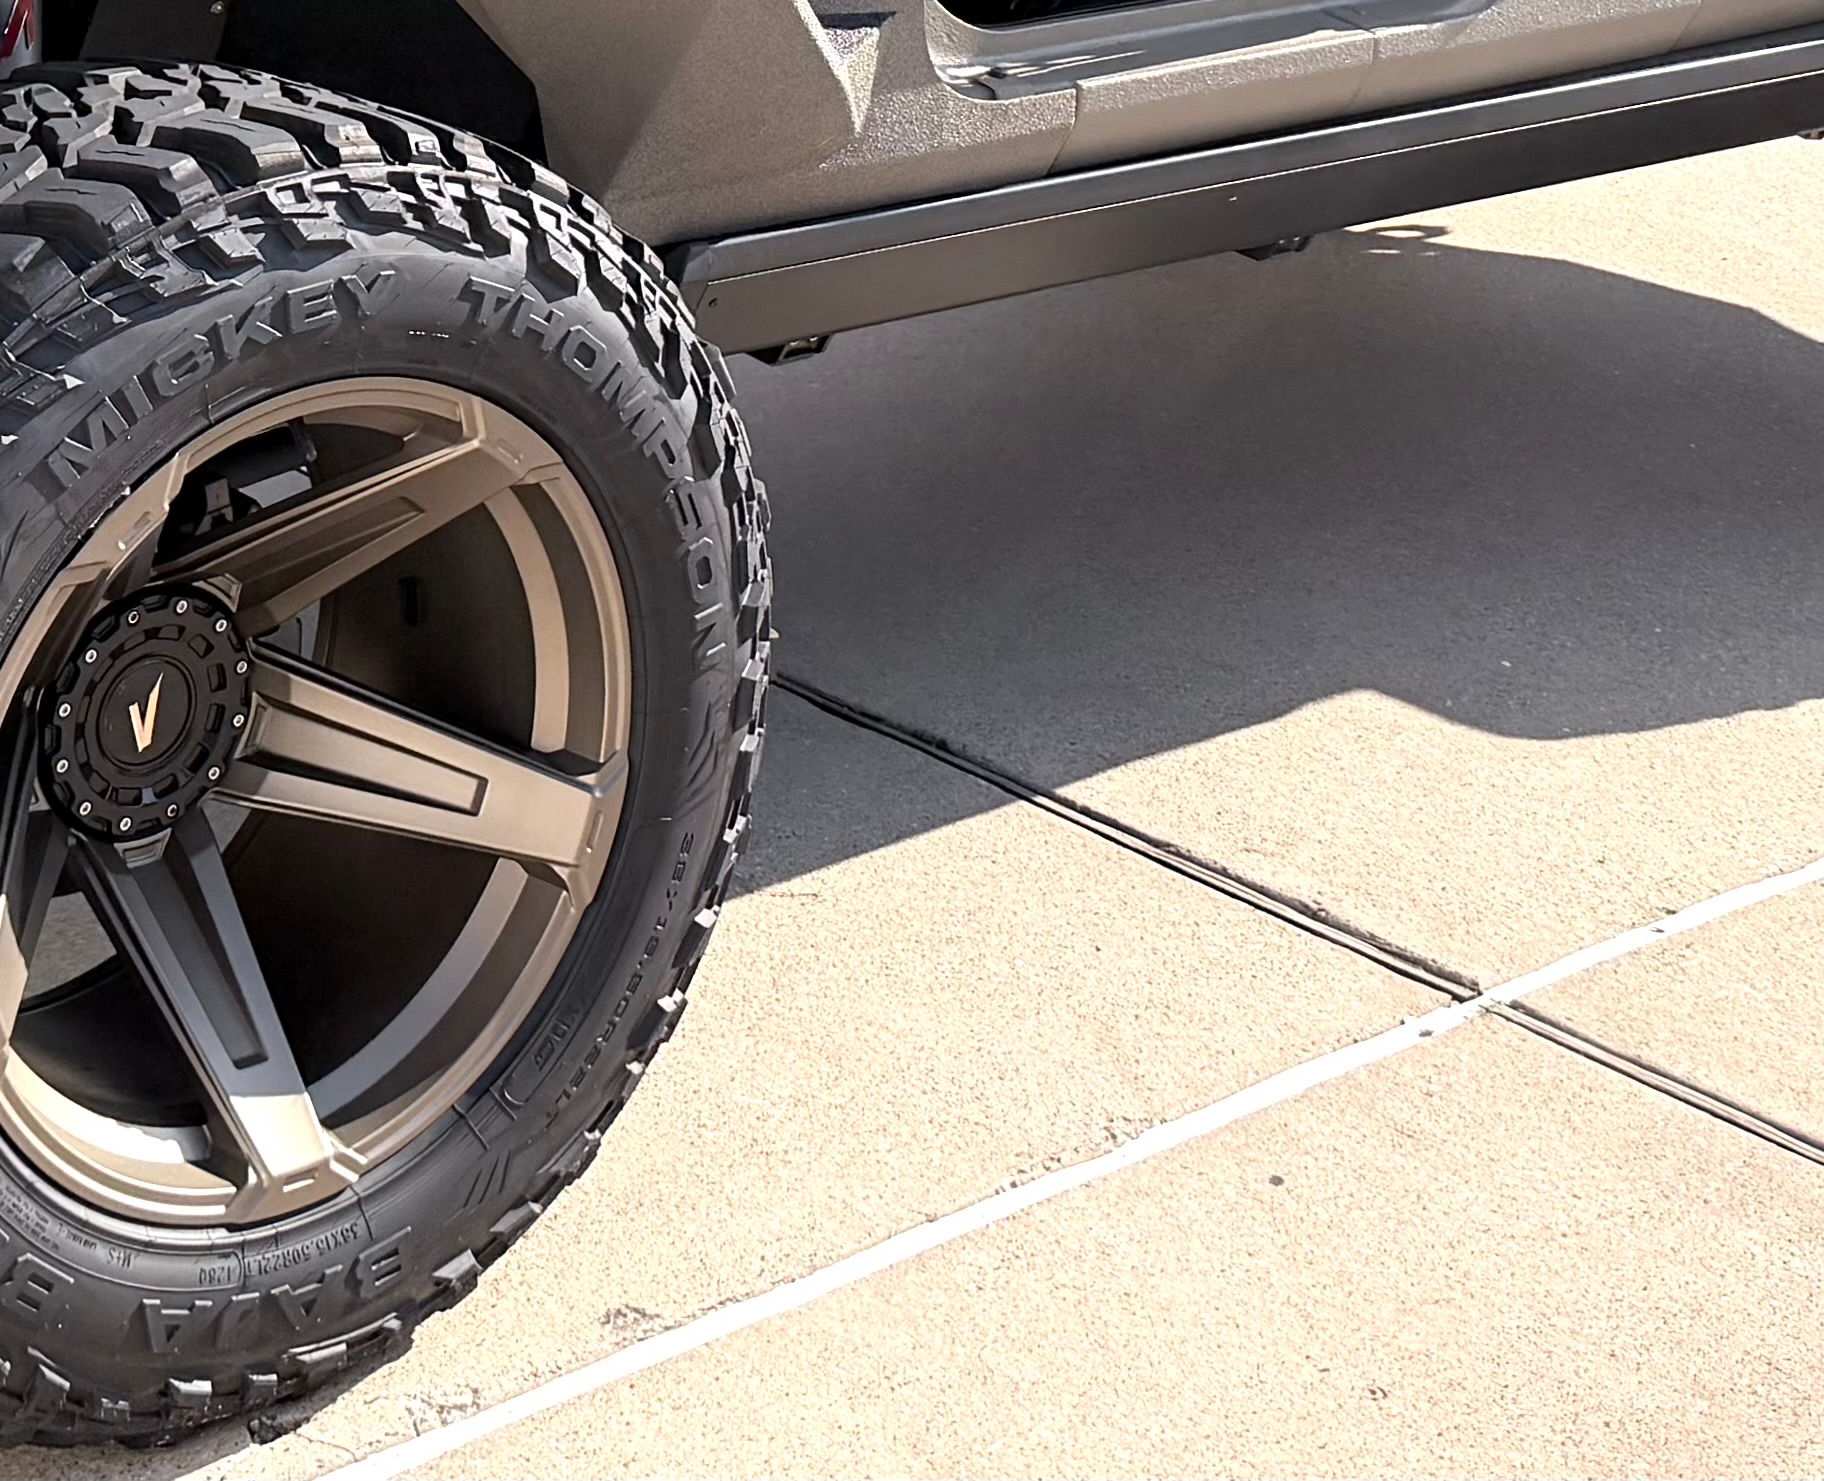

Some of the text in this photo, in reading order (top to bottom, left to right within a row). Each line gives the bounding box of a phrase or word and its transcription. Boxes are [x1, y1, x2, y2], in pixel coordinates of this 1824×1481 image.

[45, 270, 729, 673] MICKEY THOMPSON
[141, 1226, 411, 1354] BAJA
